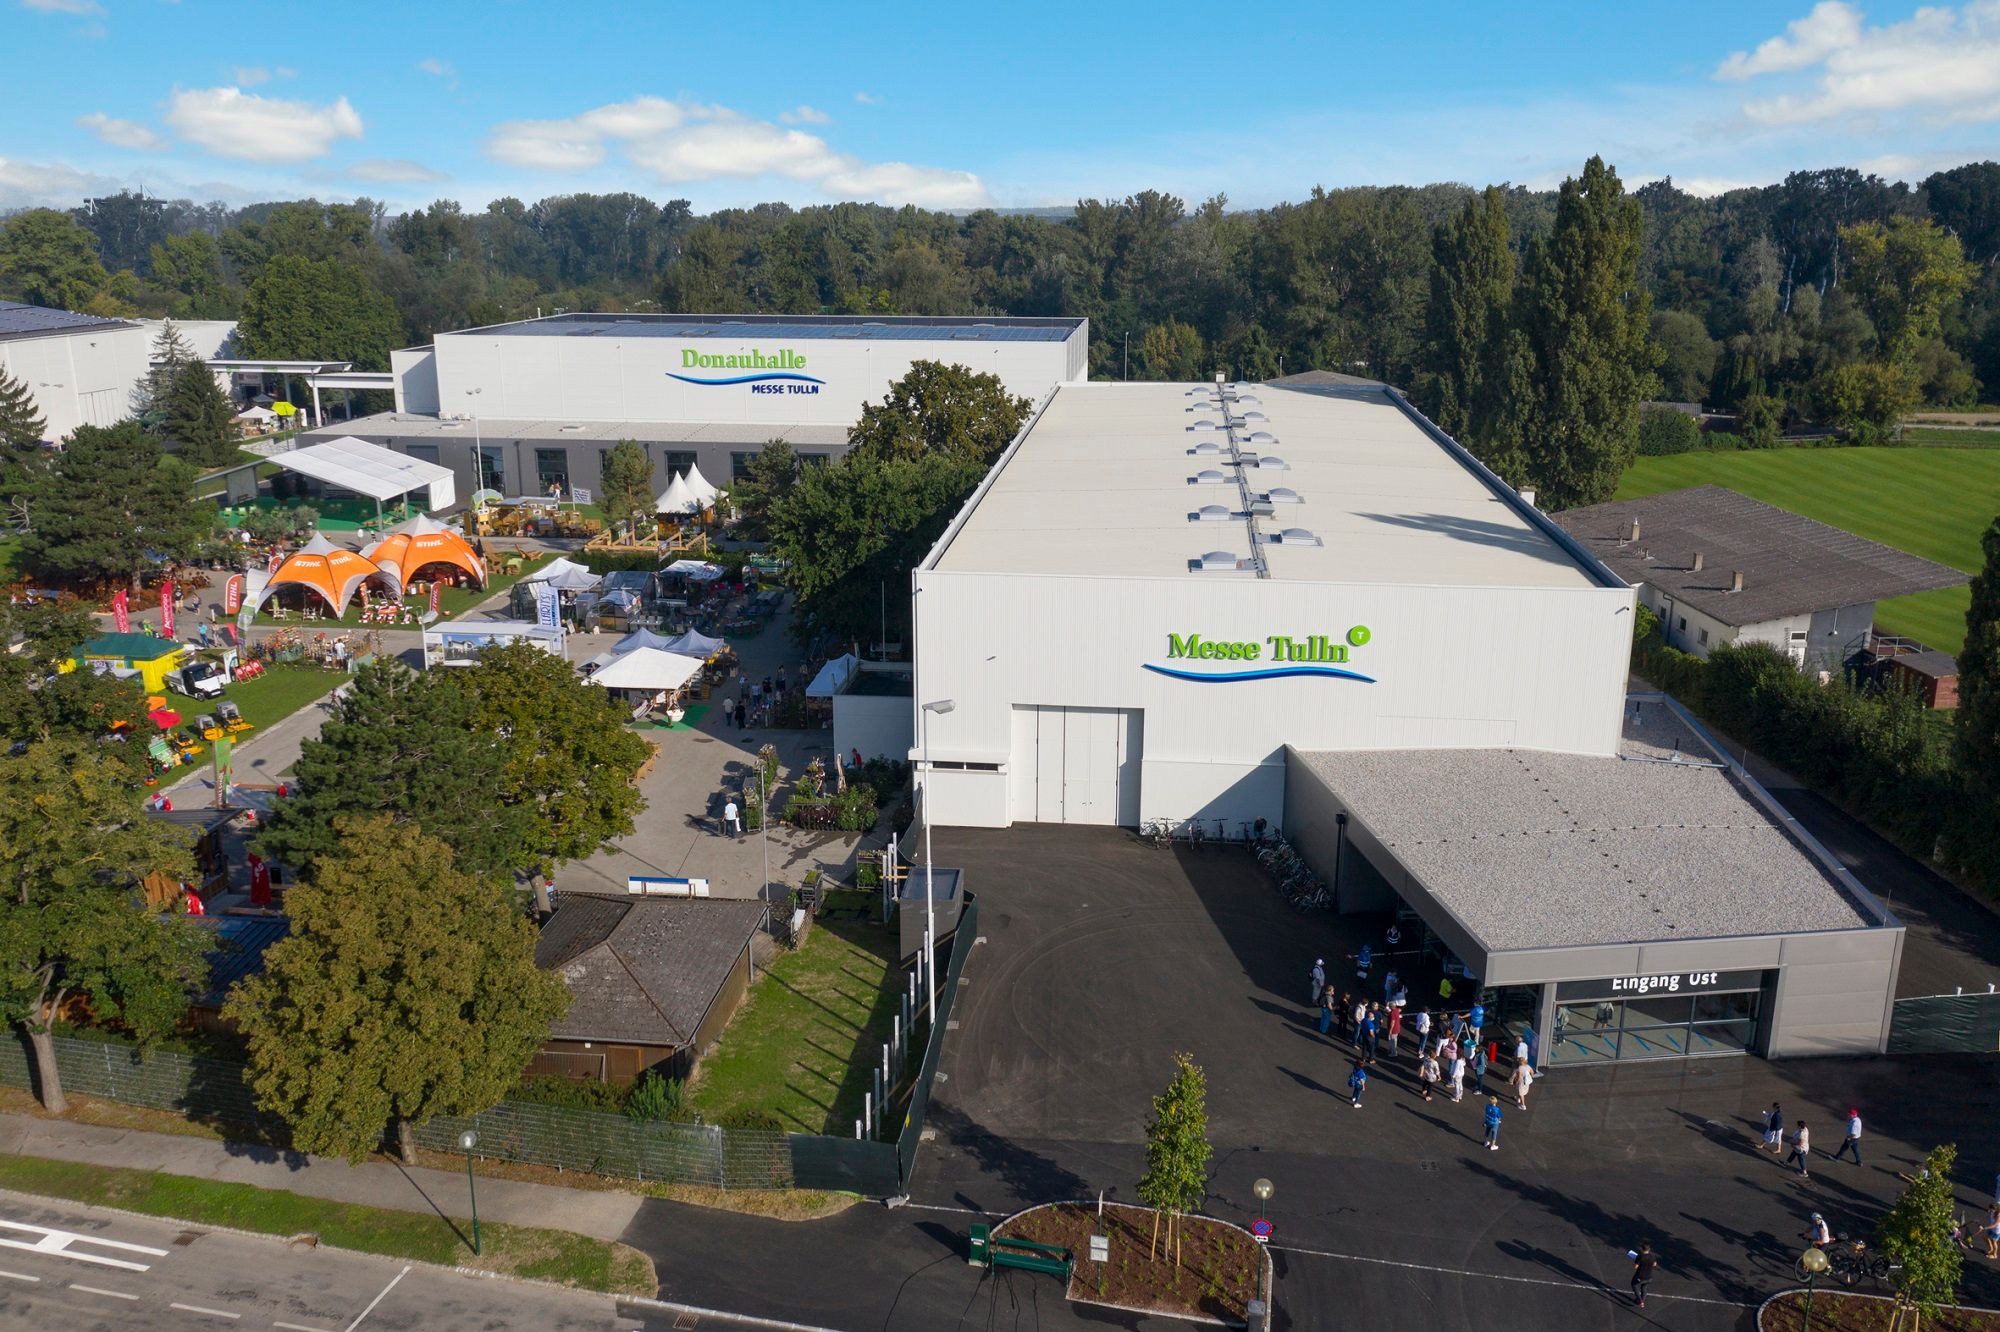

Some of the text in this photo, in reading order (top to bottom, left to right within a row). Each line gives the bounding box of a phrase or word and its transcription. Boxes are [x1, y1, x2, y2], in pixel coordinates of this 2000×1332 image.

[681, 349, 807, 369] Donauhalle
[752, 384, 819, 394] MESSE TULLN
[416, 540, 443, 548] STIHL
[294, 560, 321, 568] STIHL
[229, 582, 238, 608] STIHL
[1168, 632, 1261, 660] Messe
[1267, 635, 1350, 662] Tulln
[1612, 972, 1718, 993] Eingang Ost
